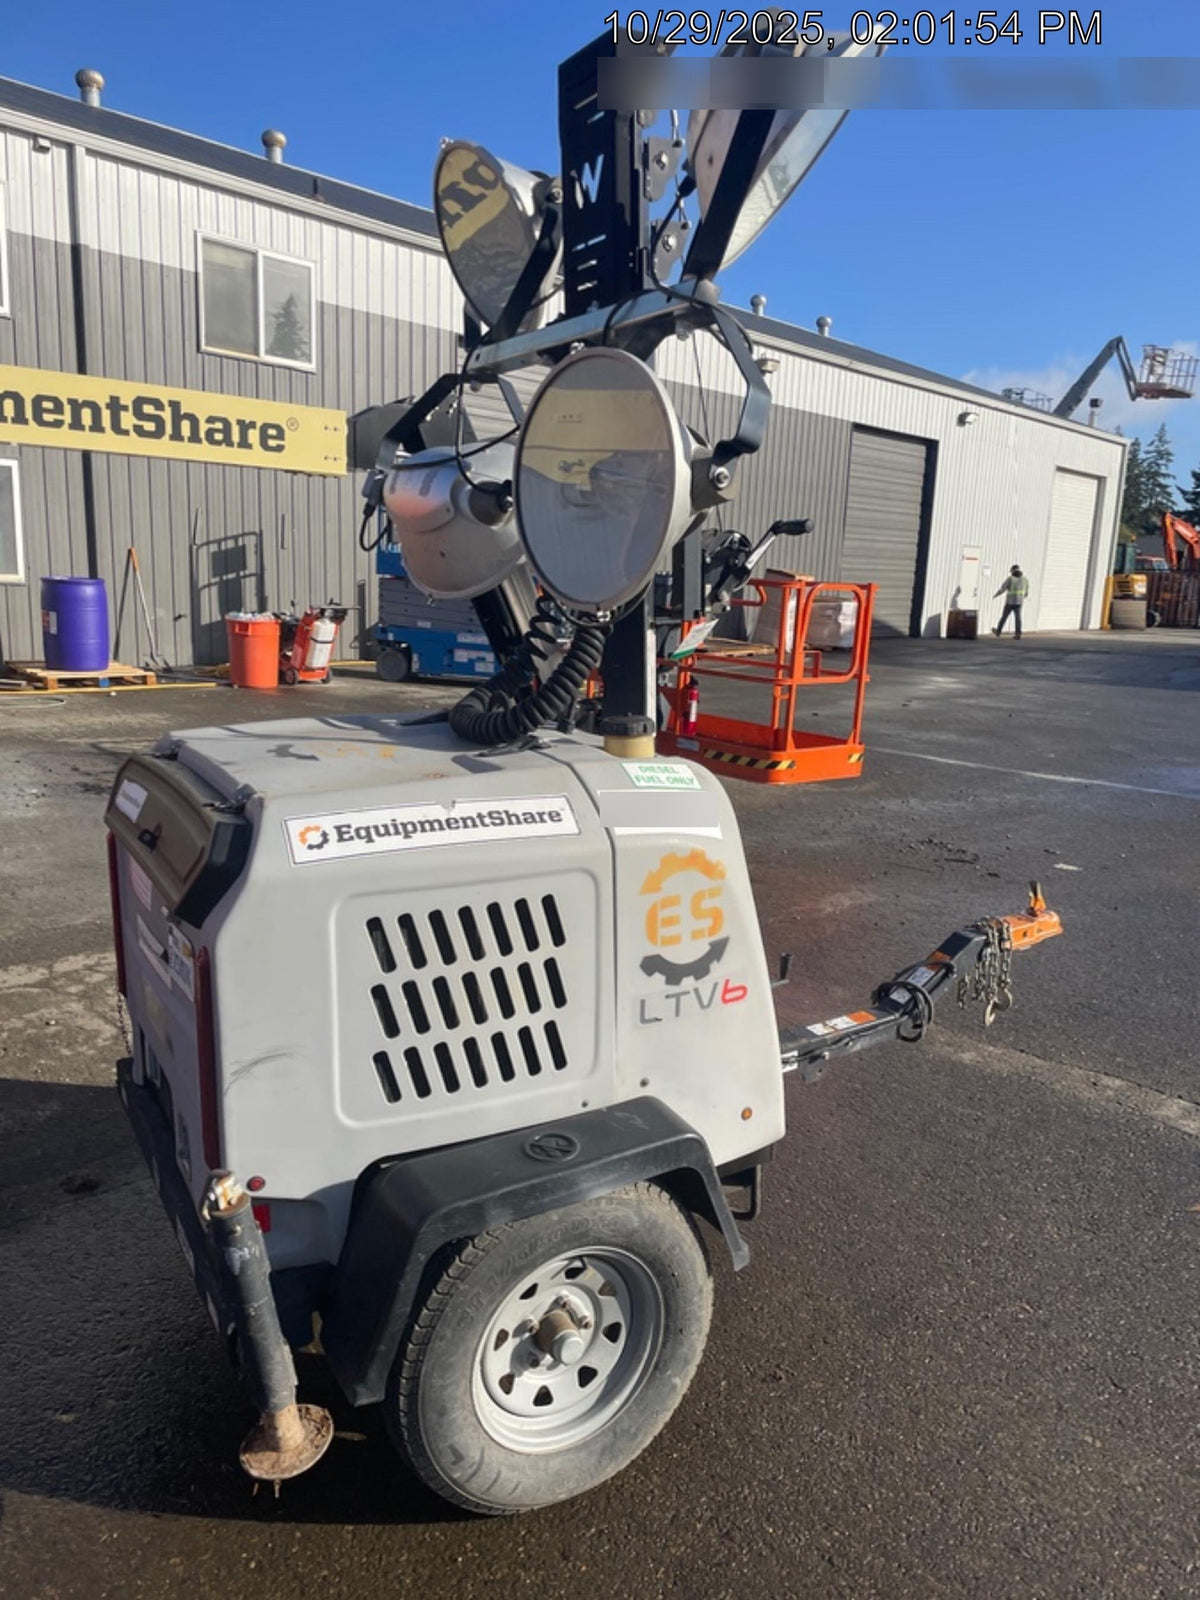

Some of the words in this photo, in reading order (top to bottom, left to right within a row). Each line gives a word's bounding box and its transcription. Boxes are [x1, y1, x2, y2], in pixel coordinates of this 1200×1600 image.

[634, 775, 665, 784] FUEL
[666, 776, 695, 785] ONLY
[638, 766, 679, 774] DIESEL
[332, 809, 563, 843] EquipmentShare
[645, 887, 724, 946] ES
